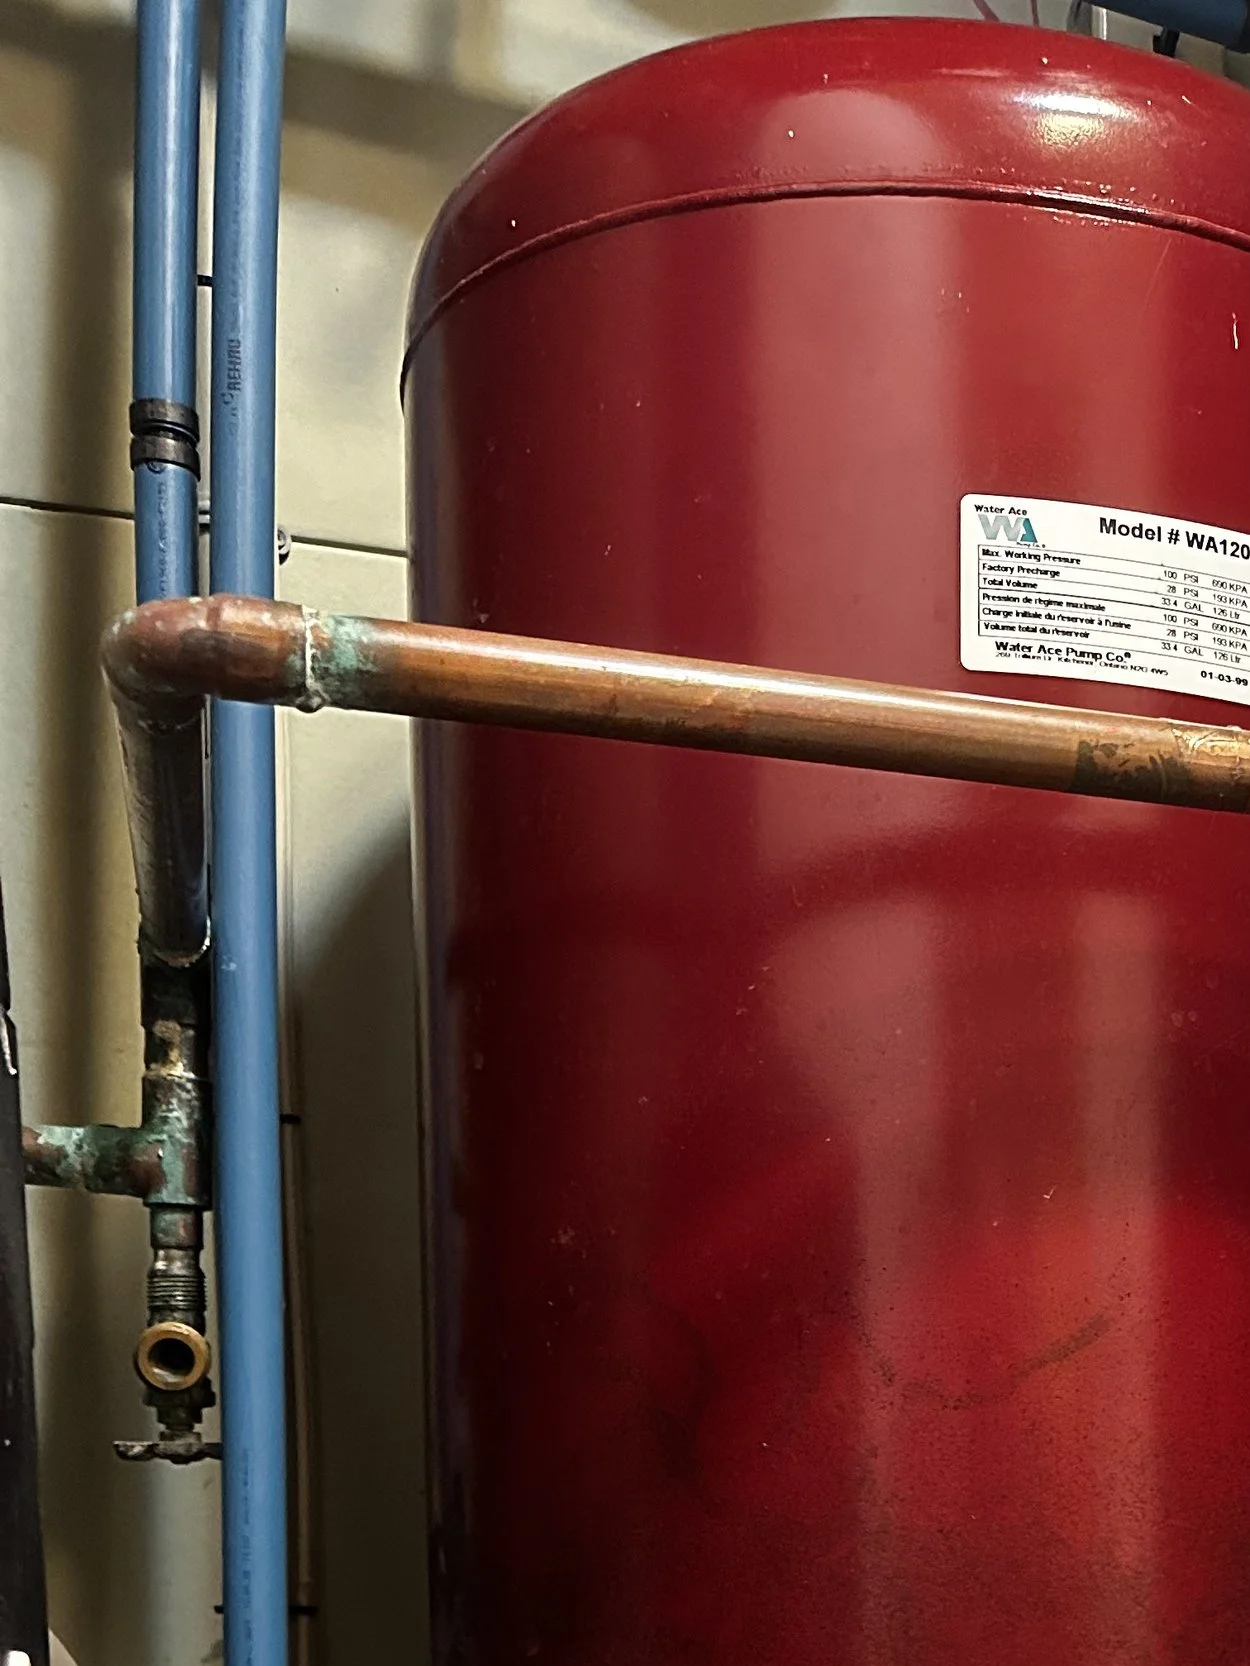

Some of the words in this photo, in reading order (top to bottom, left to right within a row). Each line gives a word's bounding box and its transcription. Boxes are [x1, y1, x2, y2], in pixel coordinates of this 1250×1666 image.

[974, 504, 1005, 514] Water
[1008, 506, 1027, 516] Ace
[1100, 517, 1161, 542] Model
[1167, 528, 1180, 545] #
[1185, 531, 1250, 560] WA120
[1005, 550, 1041, 562] Working
[1043, 553, 1081, 565] Pressure
[982, 563, 1014, 574] Factory
[1017, 566, 1060, 578] Precharge
[982, 577, 1003, 587] Total
[1006, 579, 1038, 589] Volume
[1163, 570, 1177, 579] 100
[1183, 573, 1199, 583] PSI
[1229, 581, 1248, 594] KPA
[982, 593, 1020, 603] Pression
[1022, 596, 1033, 604] de
[1066, 601, 1106, 612] maximale
[1167, 584, 1176, 594] 28
[1183, 588, 1199, 598] PSI
[1212, 593, 1227, 604] 193
[1229, 595, 1248, 608] KPA
[982, 607, 1013, 618] Charge
[1044, 612, 1056, 621] du
[1184, 601, 1204, 613] GAL
[984, 622, 1016, 632] Volume
[1018, 624, 1037, 633] total
[1039, 626, 1050, 635] du
[1163, 613, 1177, 623] 100
[1183, 617, 1199, 627] PSI
[1229, 624, 1248, 637] KPA
[1166, 628, 1176, 637] 28
[1183, 631, 1199, 641] PSI
[1212, 637, 1227, 647] 193
[1229, 638, 1248, 651] KPA
[995, 641, 1033, 653] Water
[1037, 644, 1062, 656] Ace
[1065, 647, 1103, 661] Pump
[1184, 646, 1204, 657] GAL
[1200, 670, 1249, 687] 01-03-99
